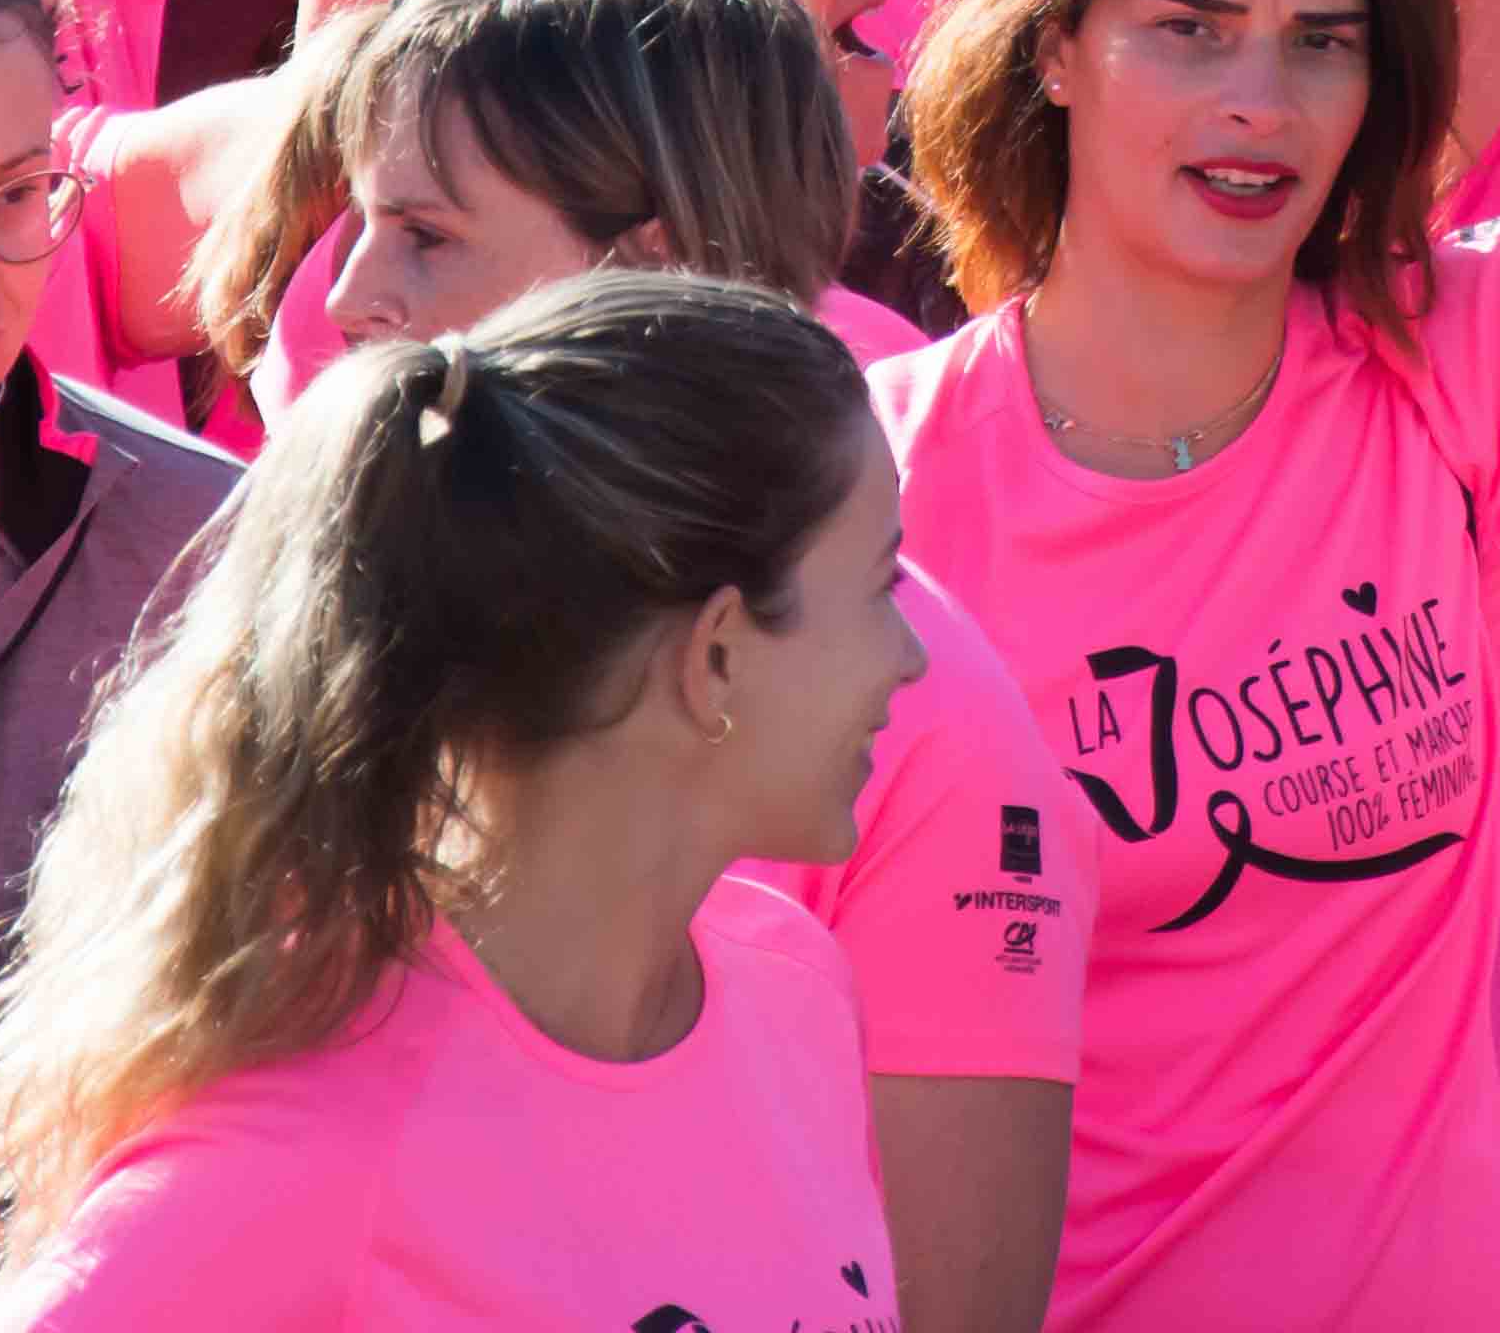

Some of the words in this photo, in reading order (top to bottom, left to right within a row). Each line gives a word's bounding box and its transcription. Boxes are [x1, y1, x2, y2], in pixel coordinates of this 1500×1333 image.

[1068, 690, 1122, 756] LA
[1263, 756, 1365, 817] COURSE
[1375, 738, 1400, 783] ET
[1326, 791, 1392, 852] 100%
[974, 890, 1061, 918] INTERSPORT
